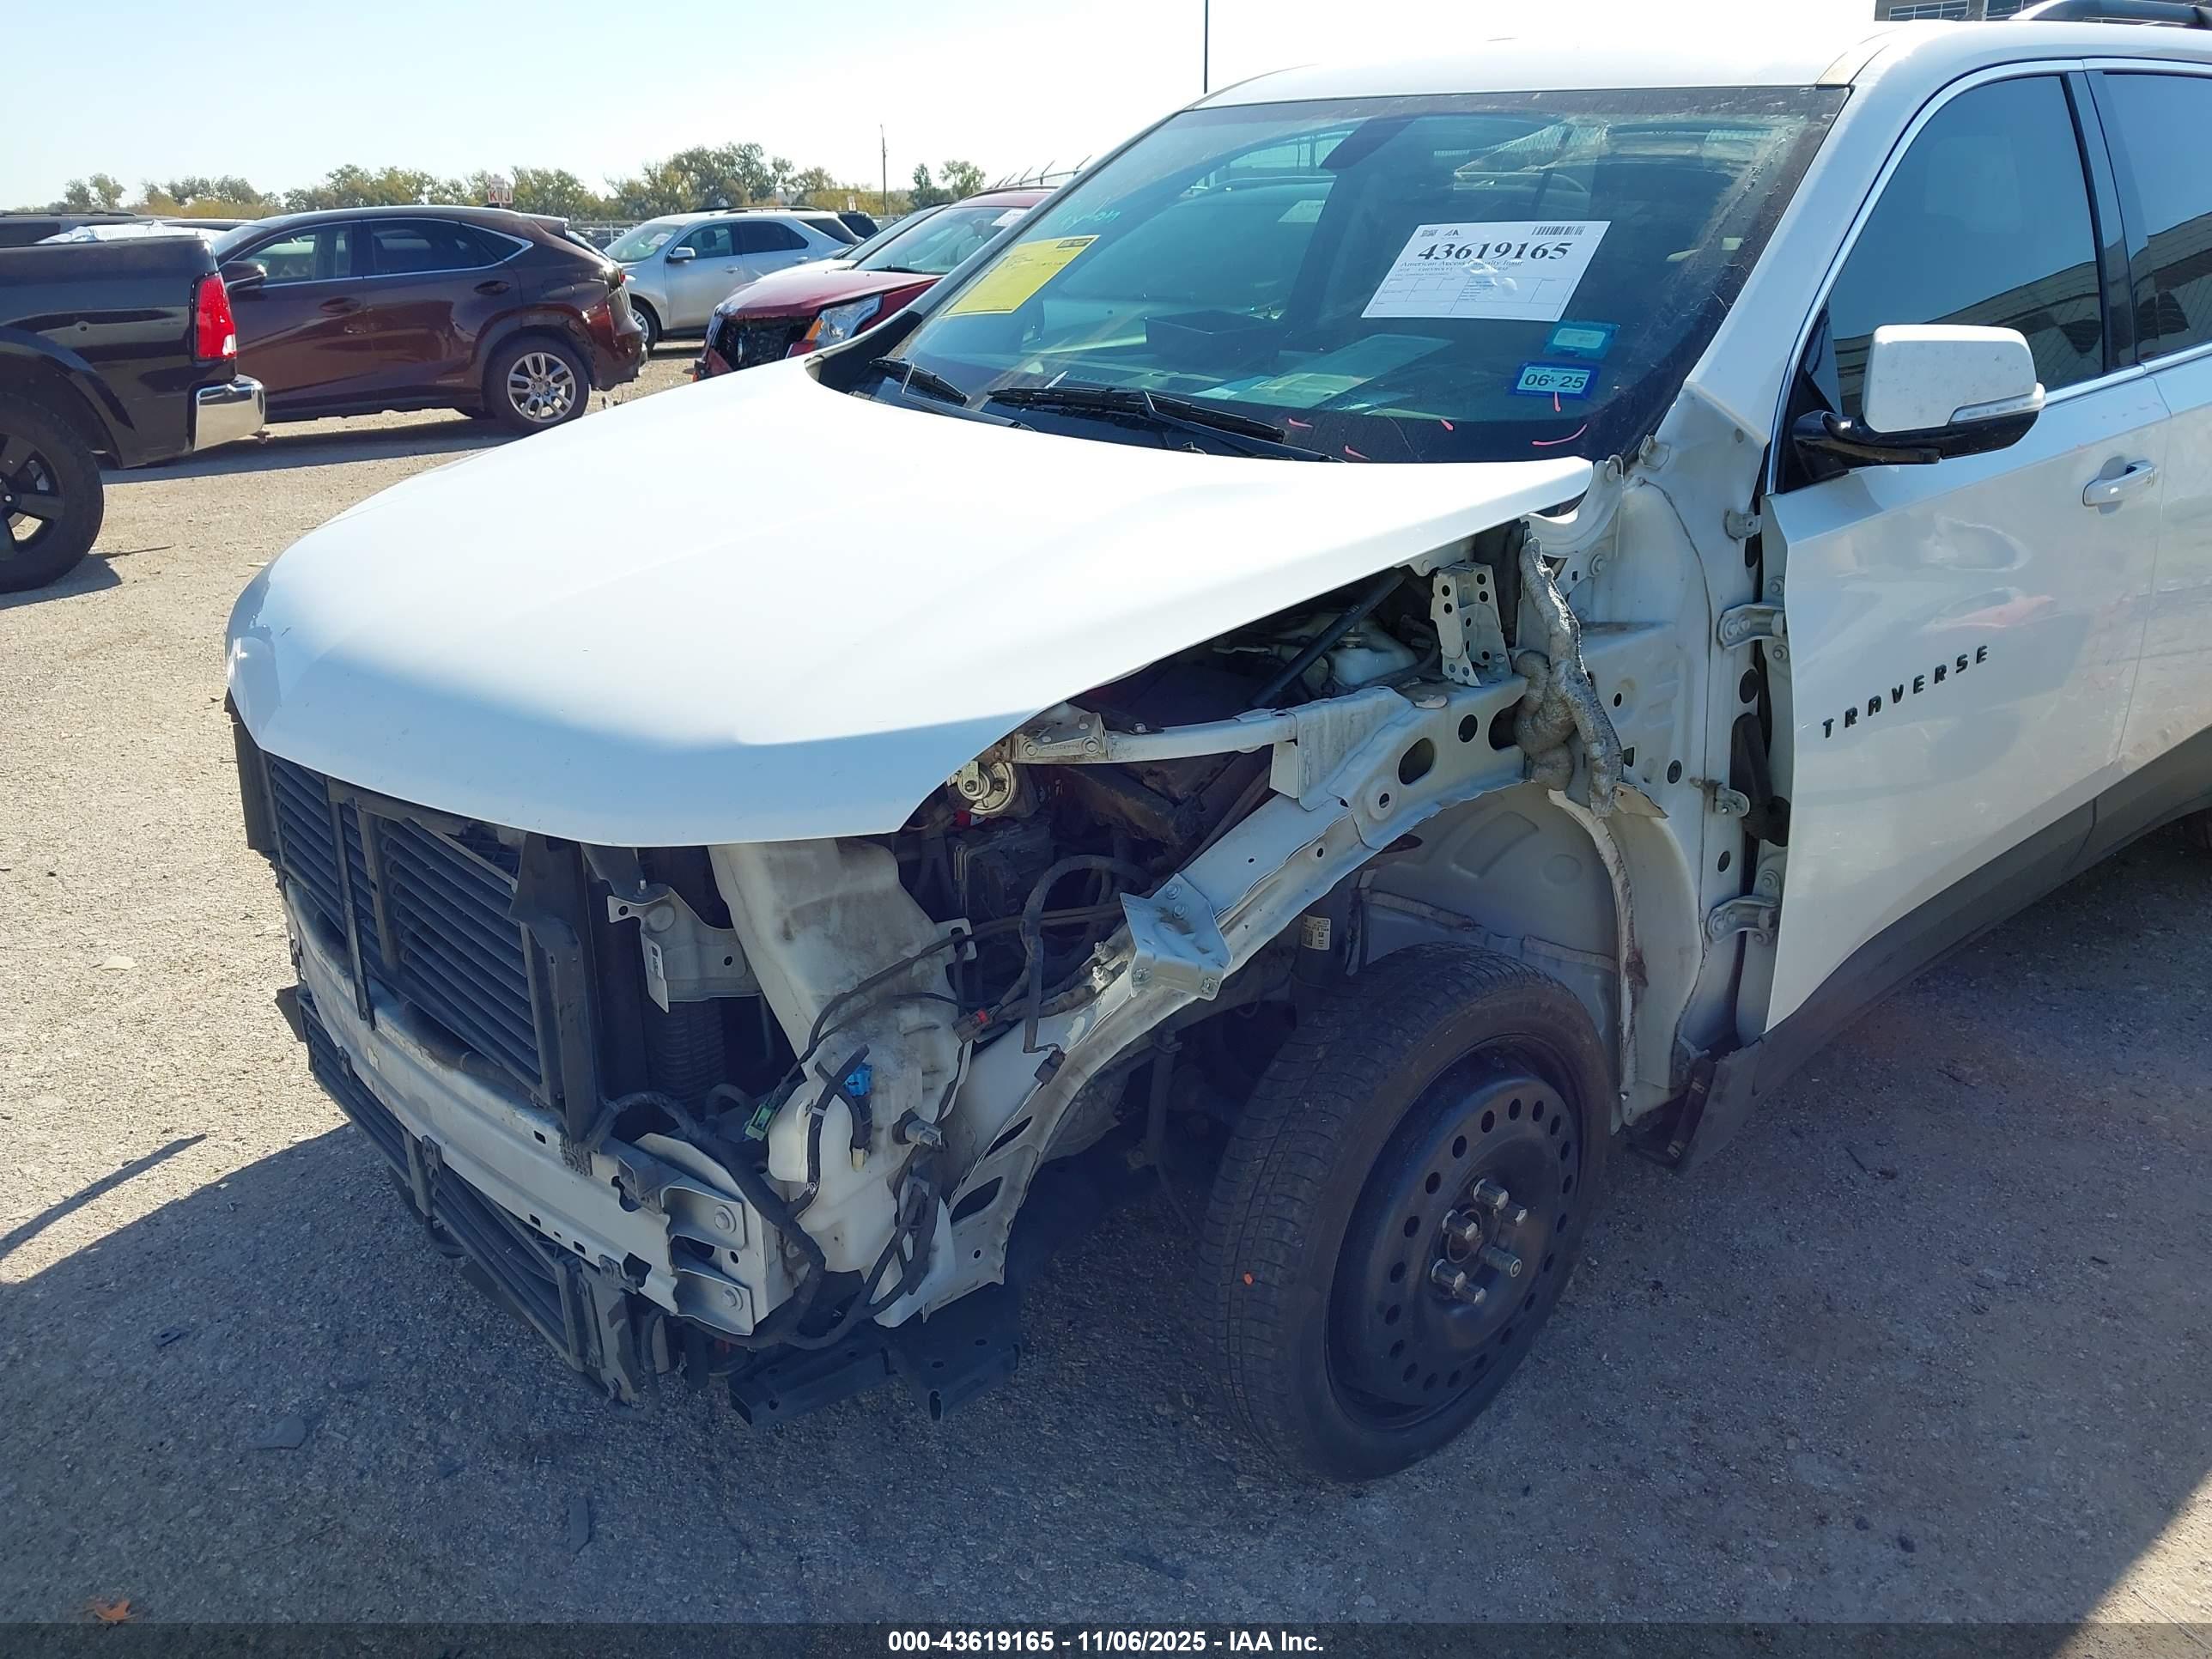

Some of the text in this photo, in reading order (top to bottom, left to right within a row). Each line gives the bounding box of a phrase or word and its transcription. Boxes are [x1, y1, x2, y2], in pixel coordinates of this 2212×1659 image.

[1418, 241, 1573, 260] 43619165
[1524, 374, 1586, 389] 06 25
[1822, 645, 1988, 738] TRAVERSE
